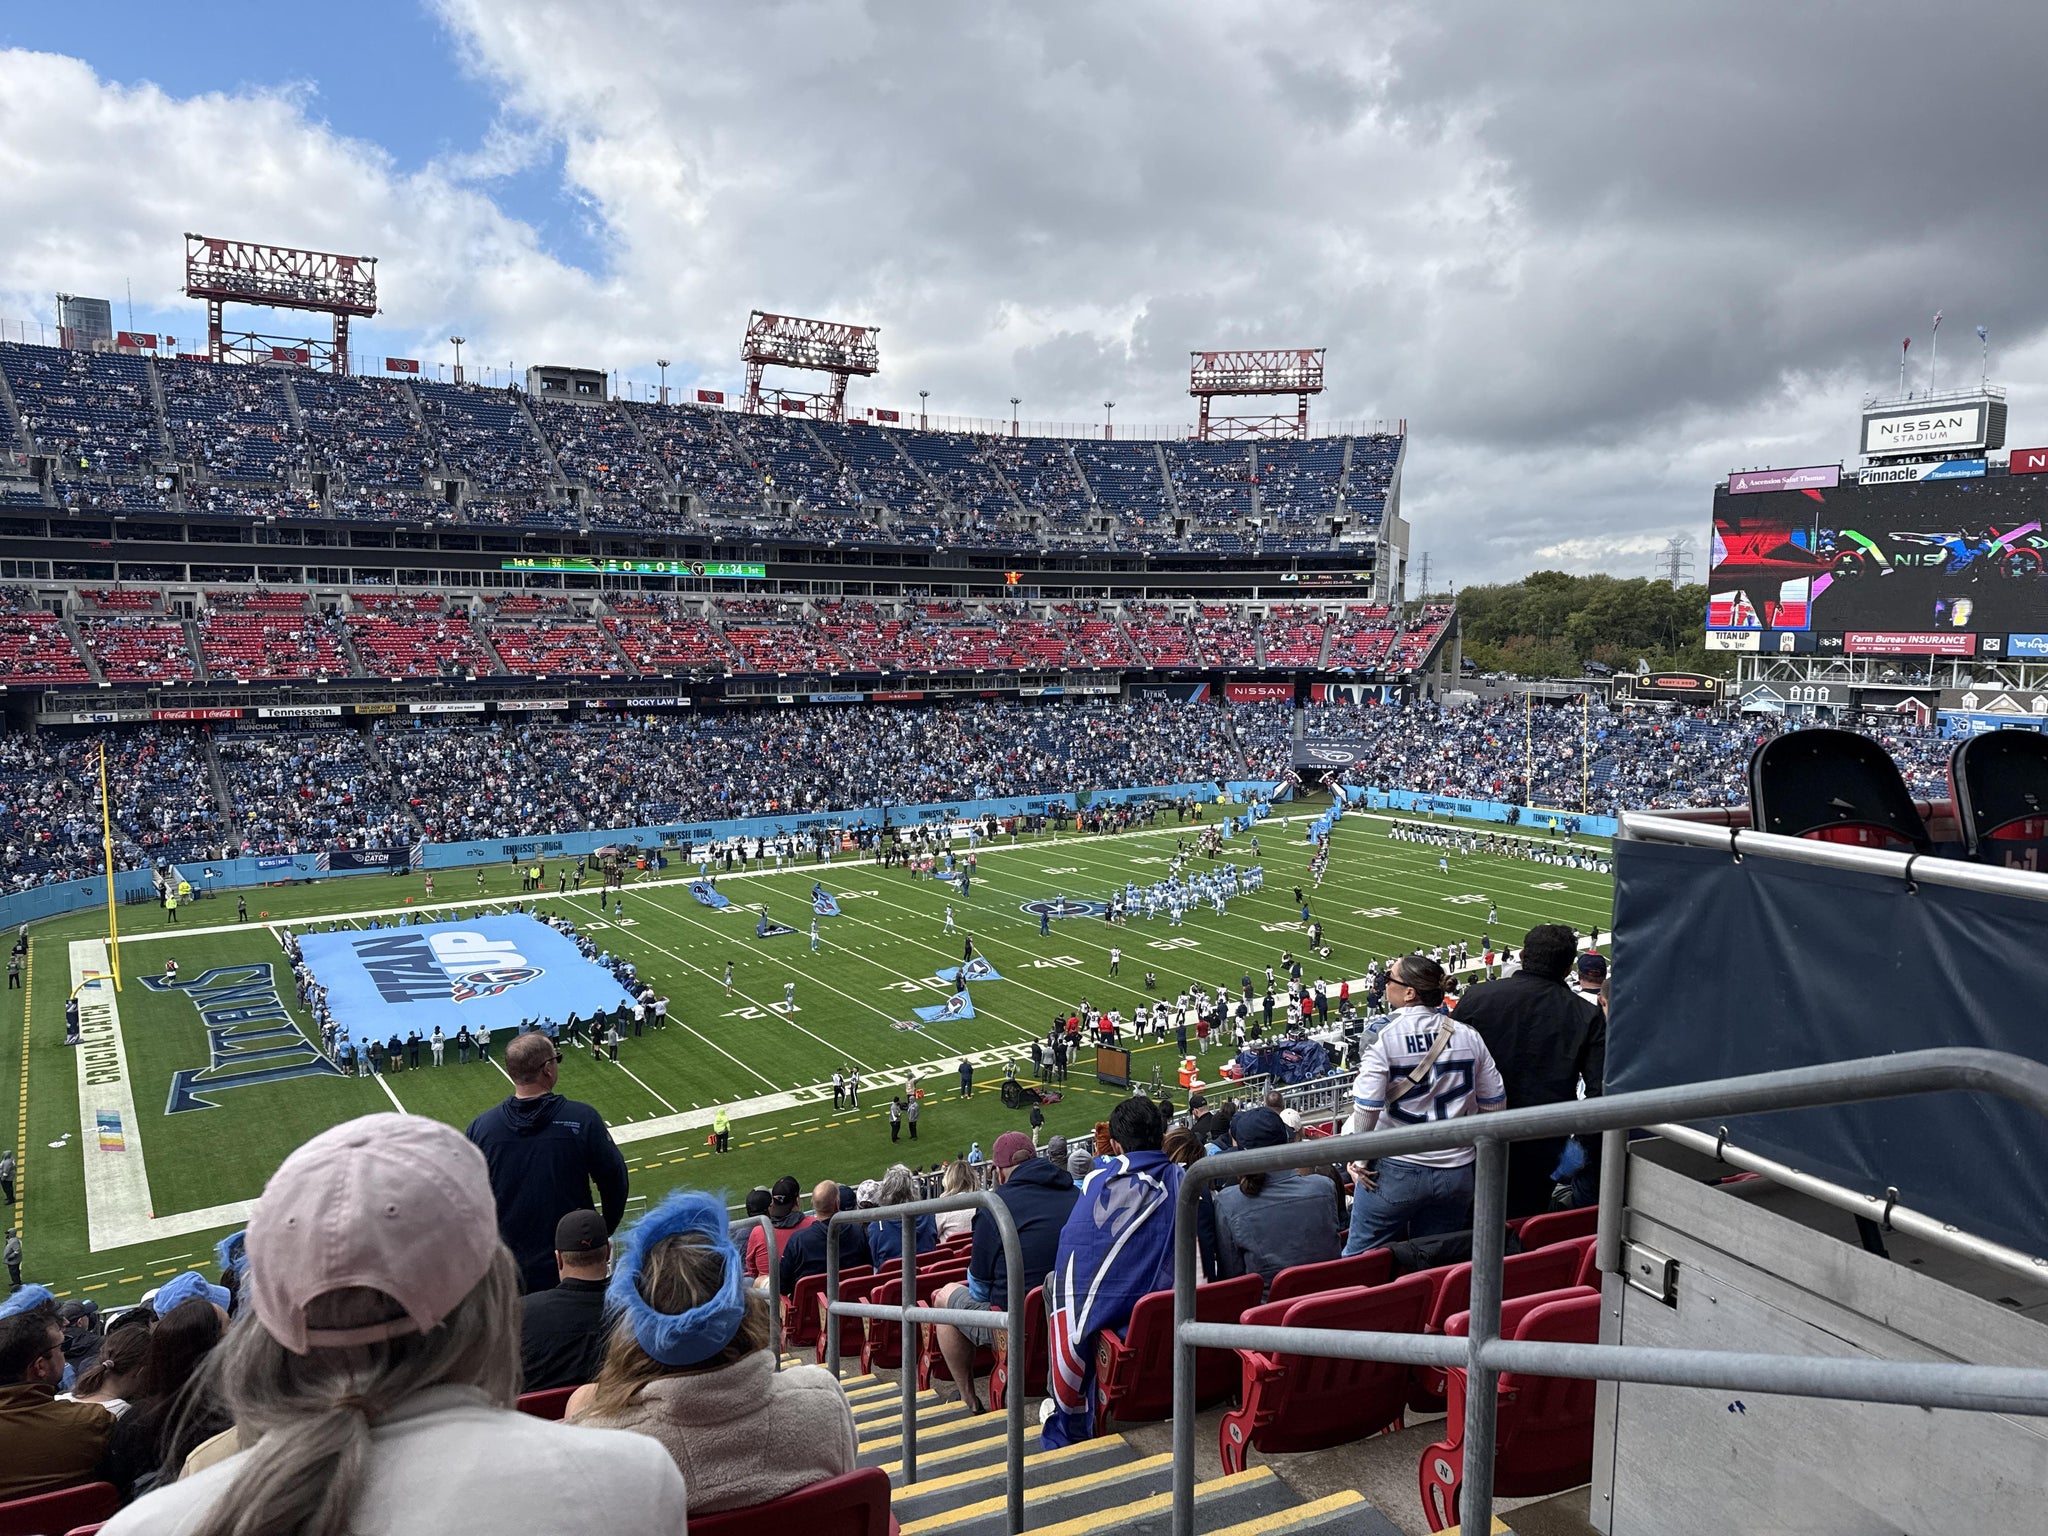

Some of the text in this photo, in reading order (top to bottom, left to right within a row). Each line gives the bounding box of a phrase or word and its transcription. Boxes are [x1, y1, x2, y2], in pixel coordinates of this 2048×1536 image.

[1881, 417, 1963, 435] NISSAN
[1893, 431, 1948, 443] STADIUM
[1860, 467, 1918, 483] Pinnacle
[1931, 468, 1985, 479] TitansBanking.com
[1750, 474, 1826, 486] Ascension Saint Thomas
[513, 558, 535, 567] 1st &
[623, 561, 632, 571] 0
[656, 562, 665, 572] 0
[718, 563, 759, 575] 6:34 1st
[1716, 631, 1750, 640] TITAN UP
[1852, 635, 1967, 645] Farm Bureau INSURANCE
[1143, 688, 1167, 699] TITANS
[1234, 687, 1286, 696] NISSAN
[586, 699, 608, 708] FedEx
[627, 699, 655, 707] ROCKY
[827, 694, 857, 702] Gallagher
[164, 711, 187, 719] Coca-Cola
[208, 710, 231, 718] Coca-Cola
[267, 708, 336, 717] Tennessean.
[236, 722, 280, 731] MUNCHAK
[1457, 802, 1472, 813] TOUGH
[659, 828, 712, 842] TENNESSEE TOUGH
[364, 854, 389, 862] CATCH
[586, 918, 640, 931] 20
[1146, 937, 1202, 951] 50
[429, 930, 529, 975] UP
[1032, 955, 1085, 969] 40
[351, 933, 453, 1004] TITAN
[889, 976, 953, 993] 30
[732, 1001, 803, 1021] 20
[80, 1003, 121, 1087] CRUCIAL CATCH
[136, 962, 351, 1116] TITANS
[1388, 1058, 1476, 1125] 22
[1232, 1427, 1241, 1439] M
[1440, 1464, 1448, 1479] N
